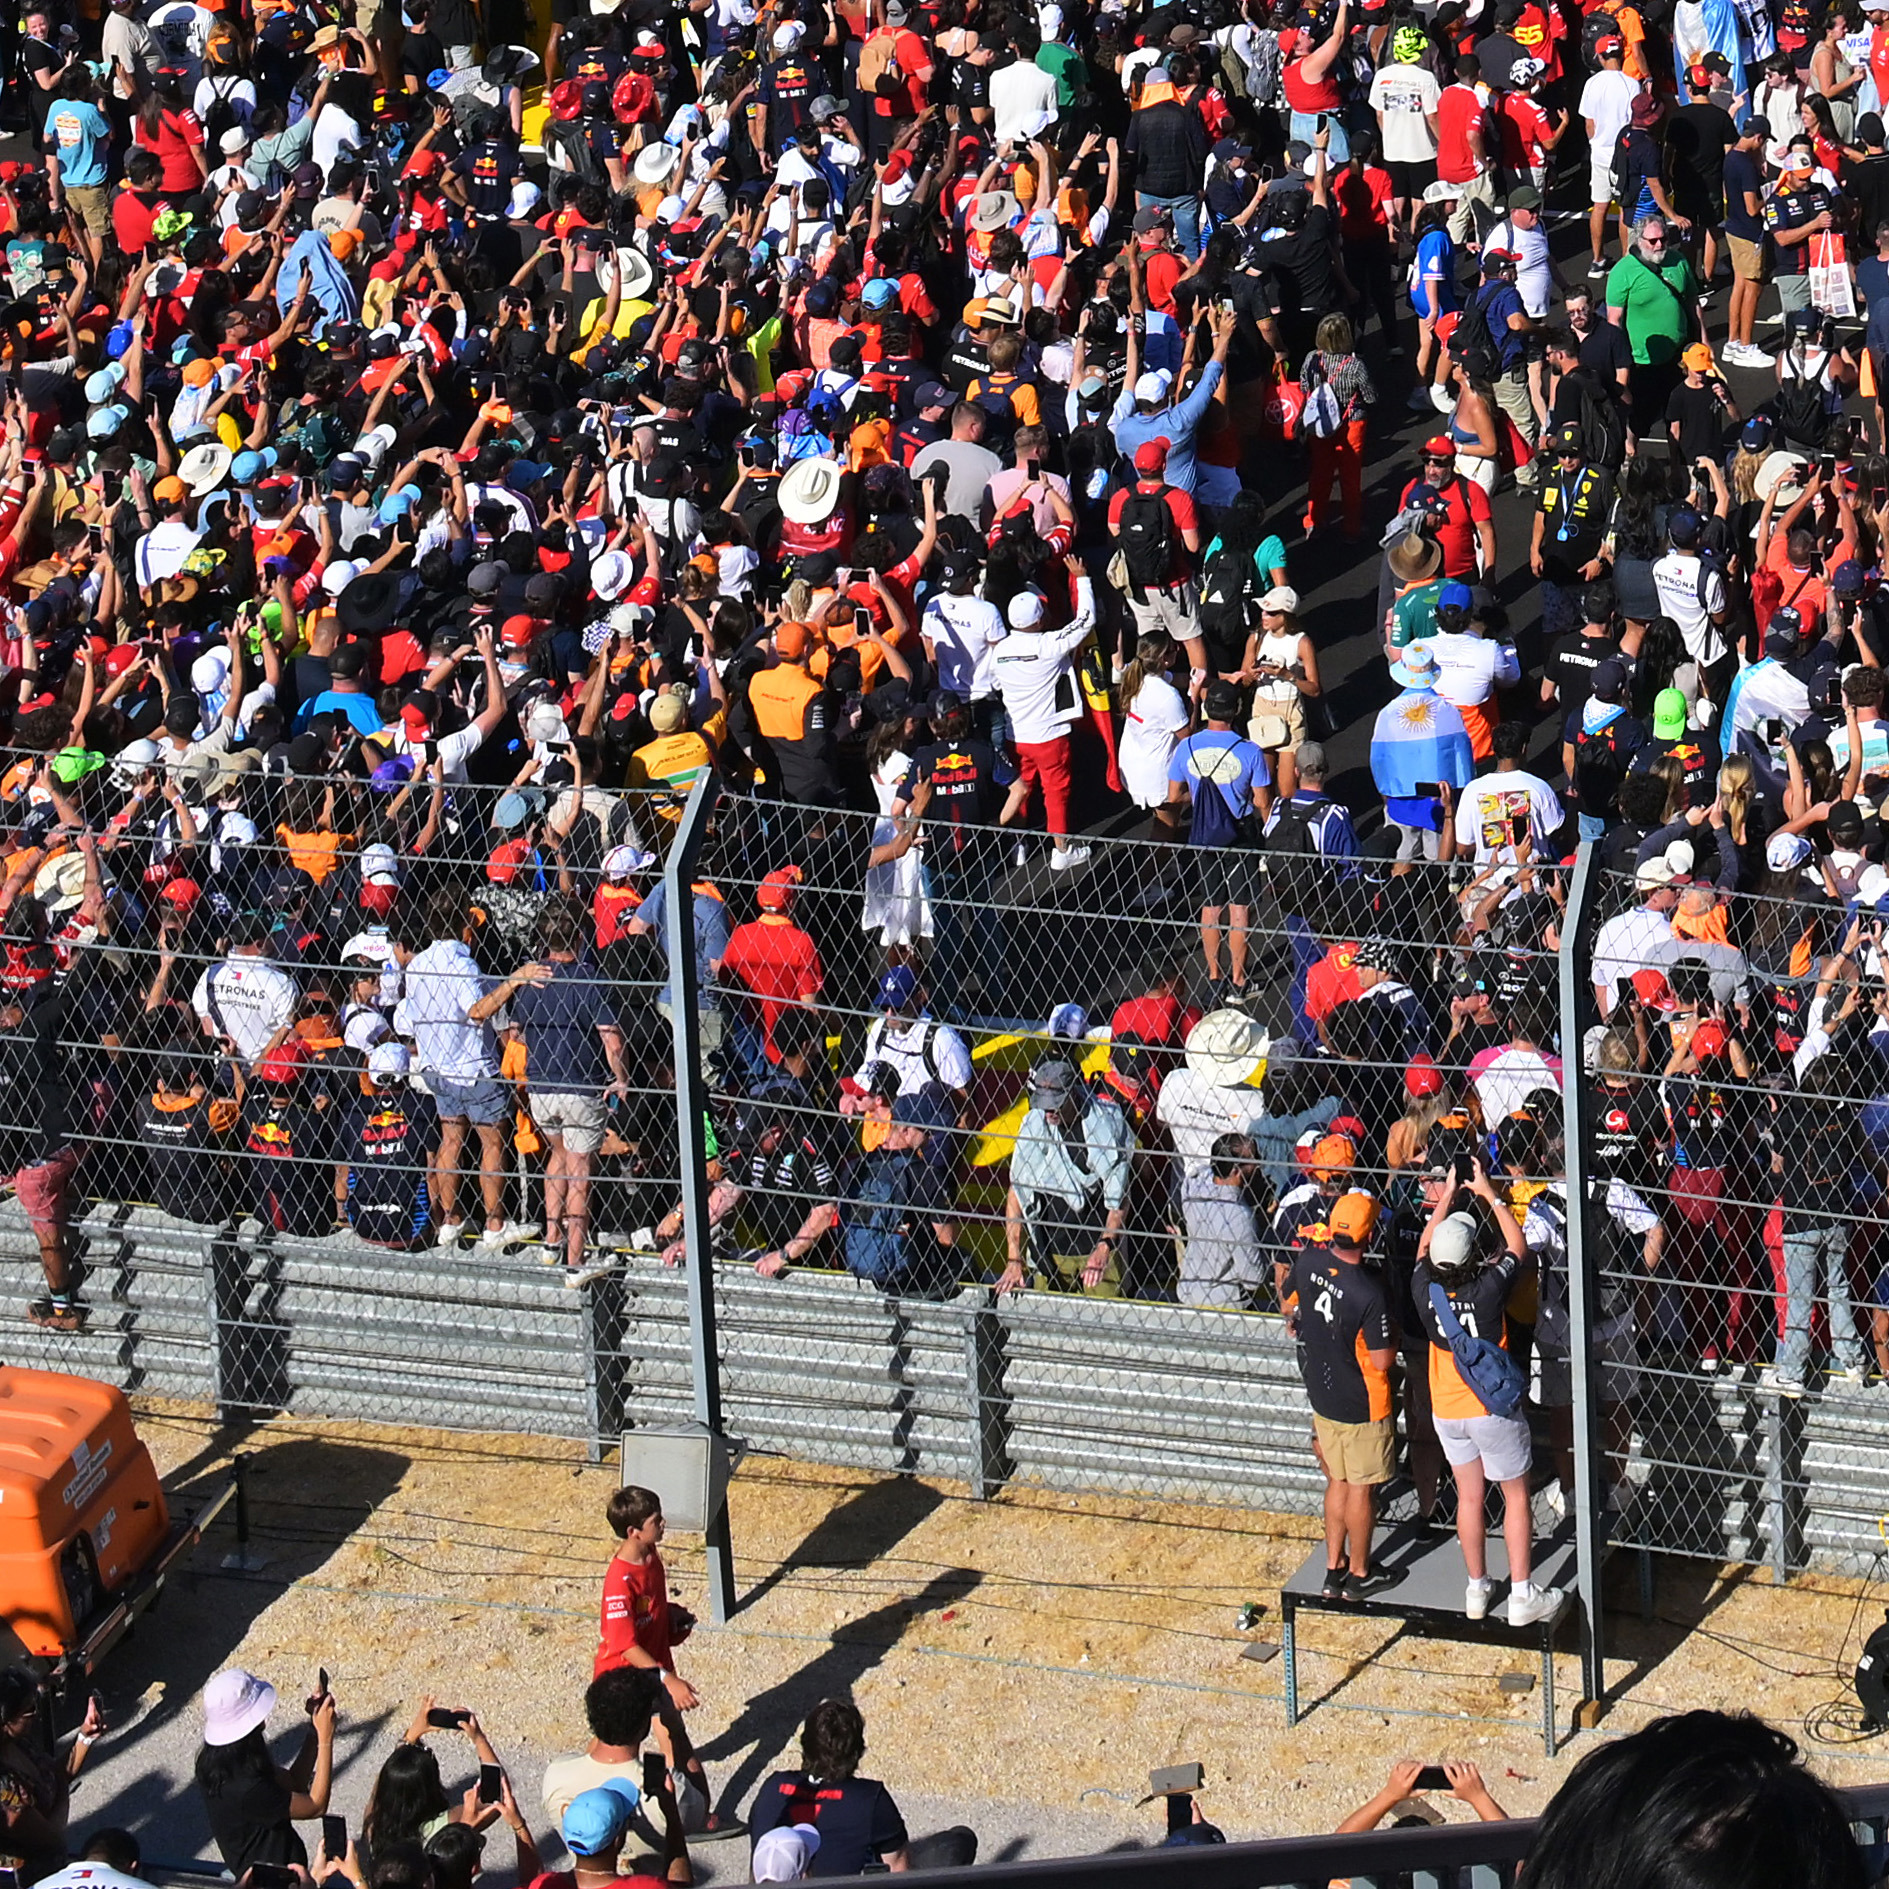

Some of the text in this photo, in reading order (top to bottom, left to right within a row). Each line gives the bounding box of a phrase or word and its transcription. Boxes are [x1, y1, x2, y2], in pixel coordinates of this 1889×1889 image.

[1514, 23, 1544, 45] 55
[1846, 38, 1871, 48] VISA
[1310, 1272, 1345, 1299] NORRIS
[1314, 1290, 1335, 1323] 4
[1427, 1300, 1476, 1311] PSTRI
